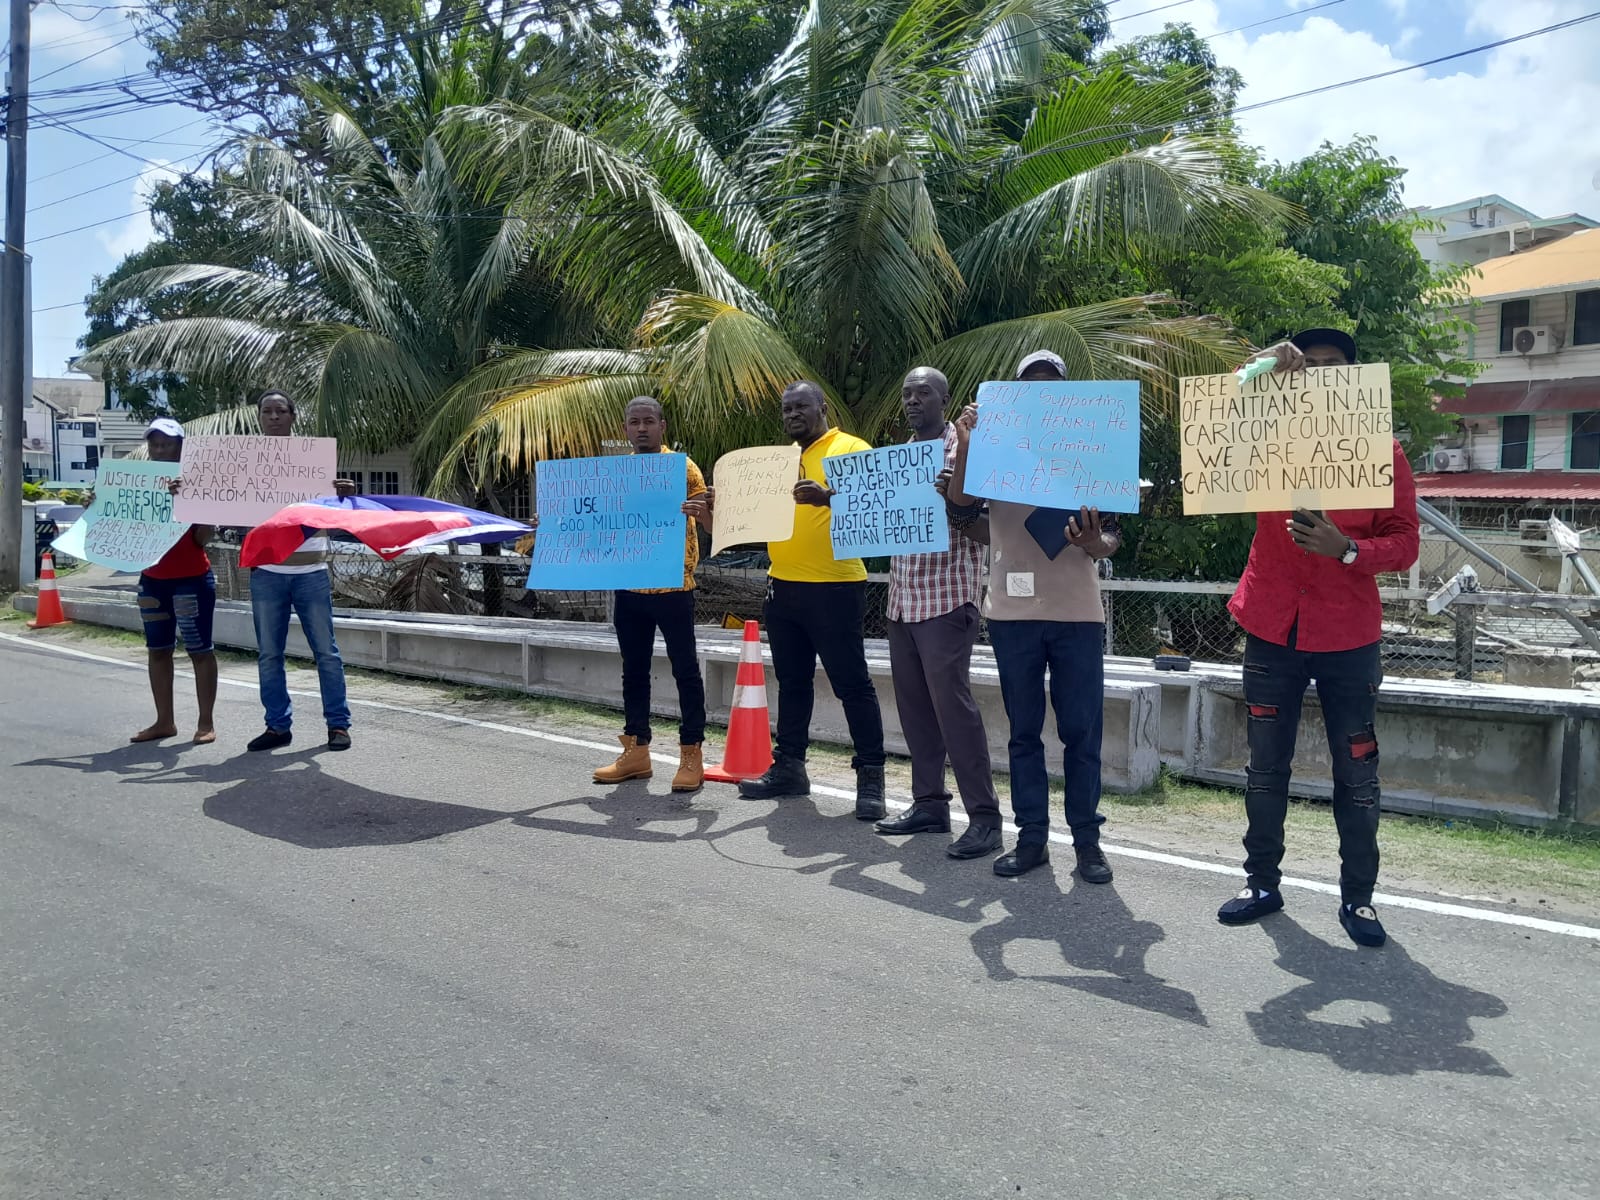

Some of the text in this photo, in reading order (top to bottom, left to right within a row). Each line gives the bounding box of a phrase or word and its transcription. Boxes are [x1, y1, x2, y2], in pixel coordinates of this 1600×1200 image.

[981, 384, 1030, 404] STOP
[1184, 376, 1227, 399] FREE
[1182, 399, 1203, 423] OF
[1210, 391, 1314, 420] HAITIANS
[1184, 411, 1392, 447] CARICOM COUNTRIES
[185, 438, 317, 451] FREE MOVEMENT OF
[1016, 437, 1030, 450] a
[1197, 437, 1369, 468] WE ARE ALSO
[183, 450, 249, 464] HAITIANS
[274, 453, 293, 465] ALL
[578, 459, 609, 478] DOES
[615, 457, 638, 476] NOT
[641, 456, 675, 474] NEED
[826, 444, 933, 479] JUSTICE POUR
[103, 471, 171, 490] JUSTICE FOR
[182, 461, 327, 480] CARICOM COUNTRIES
[857, 469, 910, 493] AGENTS
[916, 466, 936, 484] DU
[1183, 463, 1393, 495] CARICOM NATIONALS
[182, 475, 278, 490] WE ARE ALSO
[639, 475, 673, 491] TASK
[119, 488, 174, 508] PRESIDE
[181, 488, 247, 502] CARICOM
[848, 490, 896, 512] BSAP
[574, 497, 598, 515] USE
[605, 496, 625, 512] THE
[560, 517, 585, 532] 600
[592, 513, 650, 530] MILLION
[831, 506, 935, 532] JUSTICE FOR THE
[599, 531, 617, 546] THE
[626, 529, 664, 545] POLICE
[832, 524, 935, 547] HAITIAN PEOPLE
